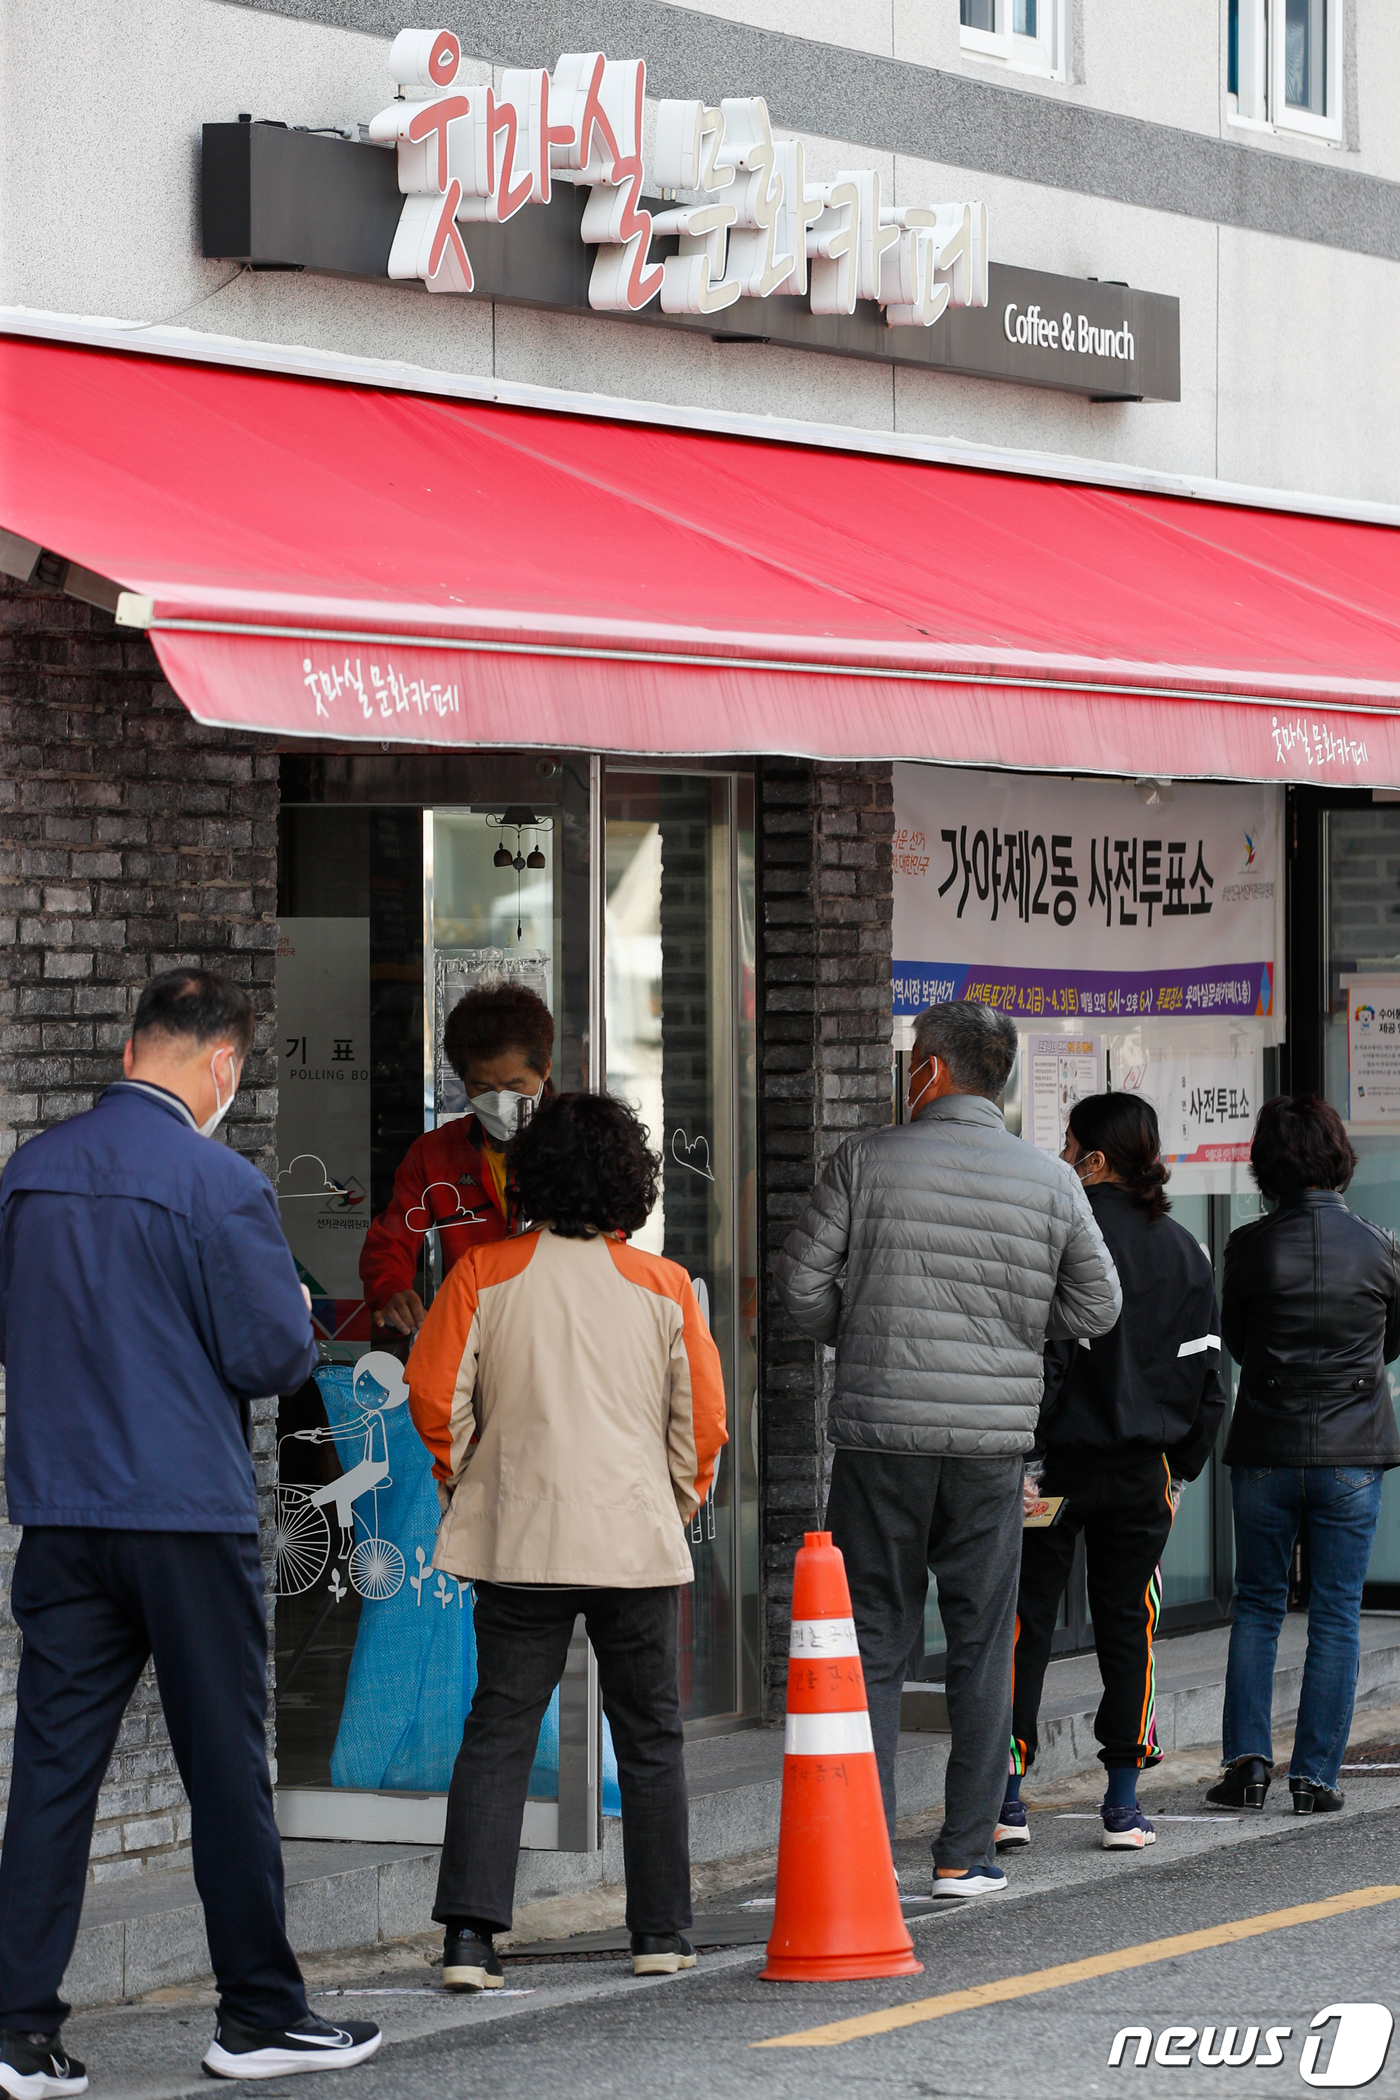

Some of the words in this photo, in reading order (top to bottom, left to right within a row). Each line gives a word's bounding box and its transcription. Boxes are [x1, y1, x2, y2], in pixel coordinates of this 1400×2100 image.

[1004, 303, 1059, 349] Coffee
[1061, 311, 1075, 352] &
[1077, 315, 1135, 361] Brunch
[909, 831, 926, 851] 선거
[938, 825, 1079, 927] 가야제2동
[1088, 836, 1214, 927] 사전투표소
[922, 980, 956, 1006] 보궐선거
[964, 983, 1017, 1011] 사전투표기간
[1094, 992, 1106, 1013] 오전
[1140, 988, 1153, 1013] 6시
[1156, 986, 1184, 1012] 투표장소
[1379, 1023, 1396, 1034] 제공
[290, 1069, 344, 1081] POLLING
[1190, 1087, 1249, 1125] 사전투표소
[316, 1218, 369, 1230] 선거관리위원회
